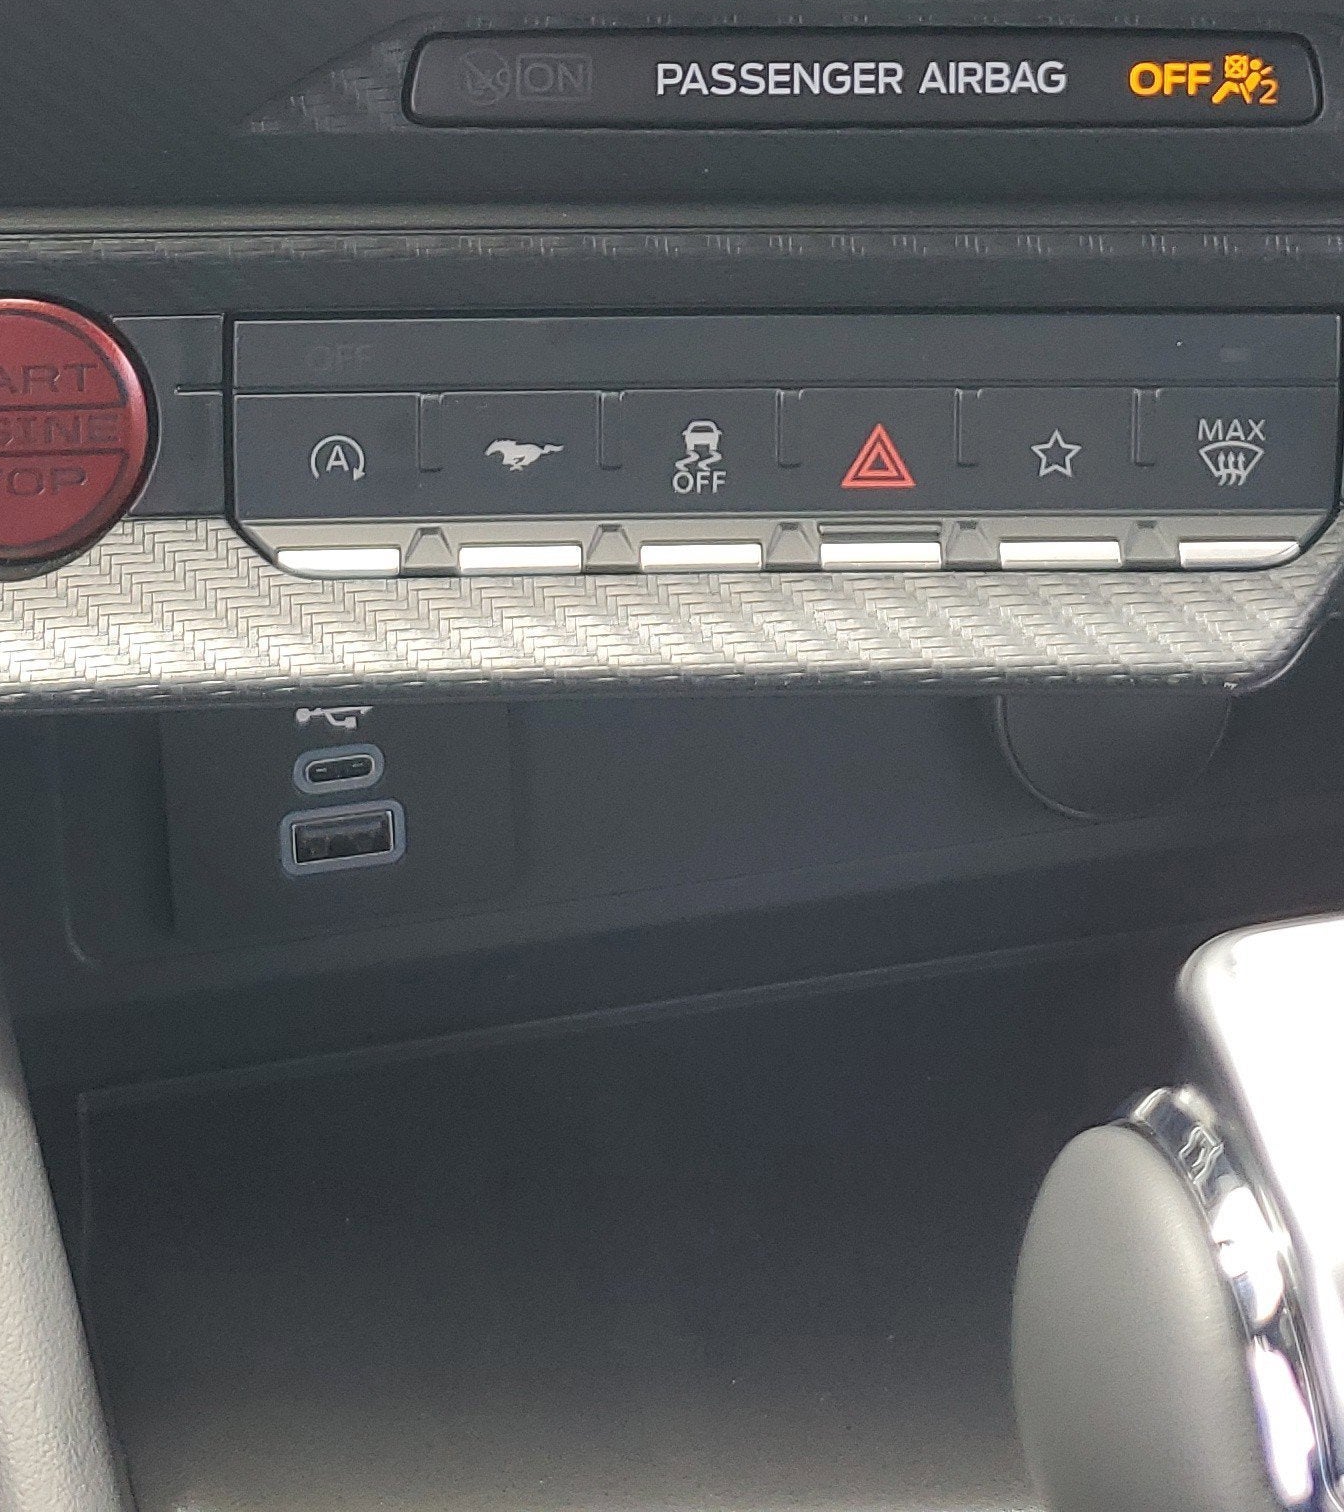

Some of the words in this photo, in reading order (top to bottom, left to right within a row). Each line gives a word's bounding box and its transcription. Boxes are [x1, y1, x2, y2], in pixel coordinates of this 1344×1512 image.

[656, 61, 903, 96] PASSENGER
[918, 60, 1067, 95] AIRBAG
[1129, 61, 1212, 97] OFF
[1197, 419, 1267, 442] MAX
[672, 470, 727, 494] OFF
